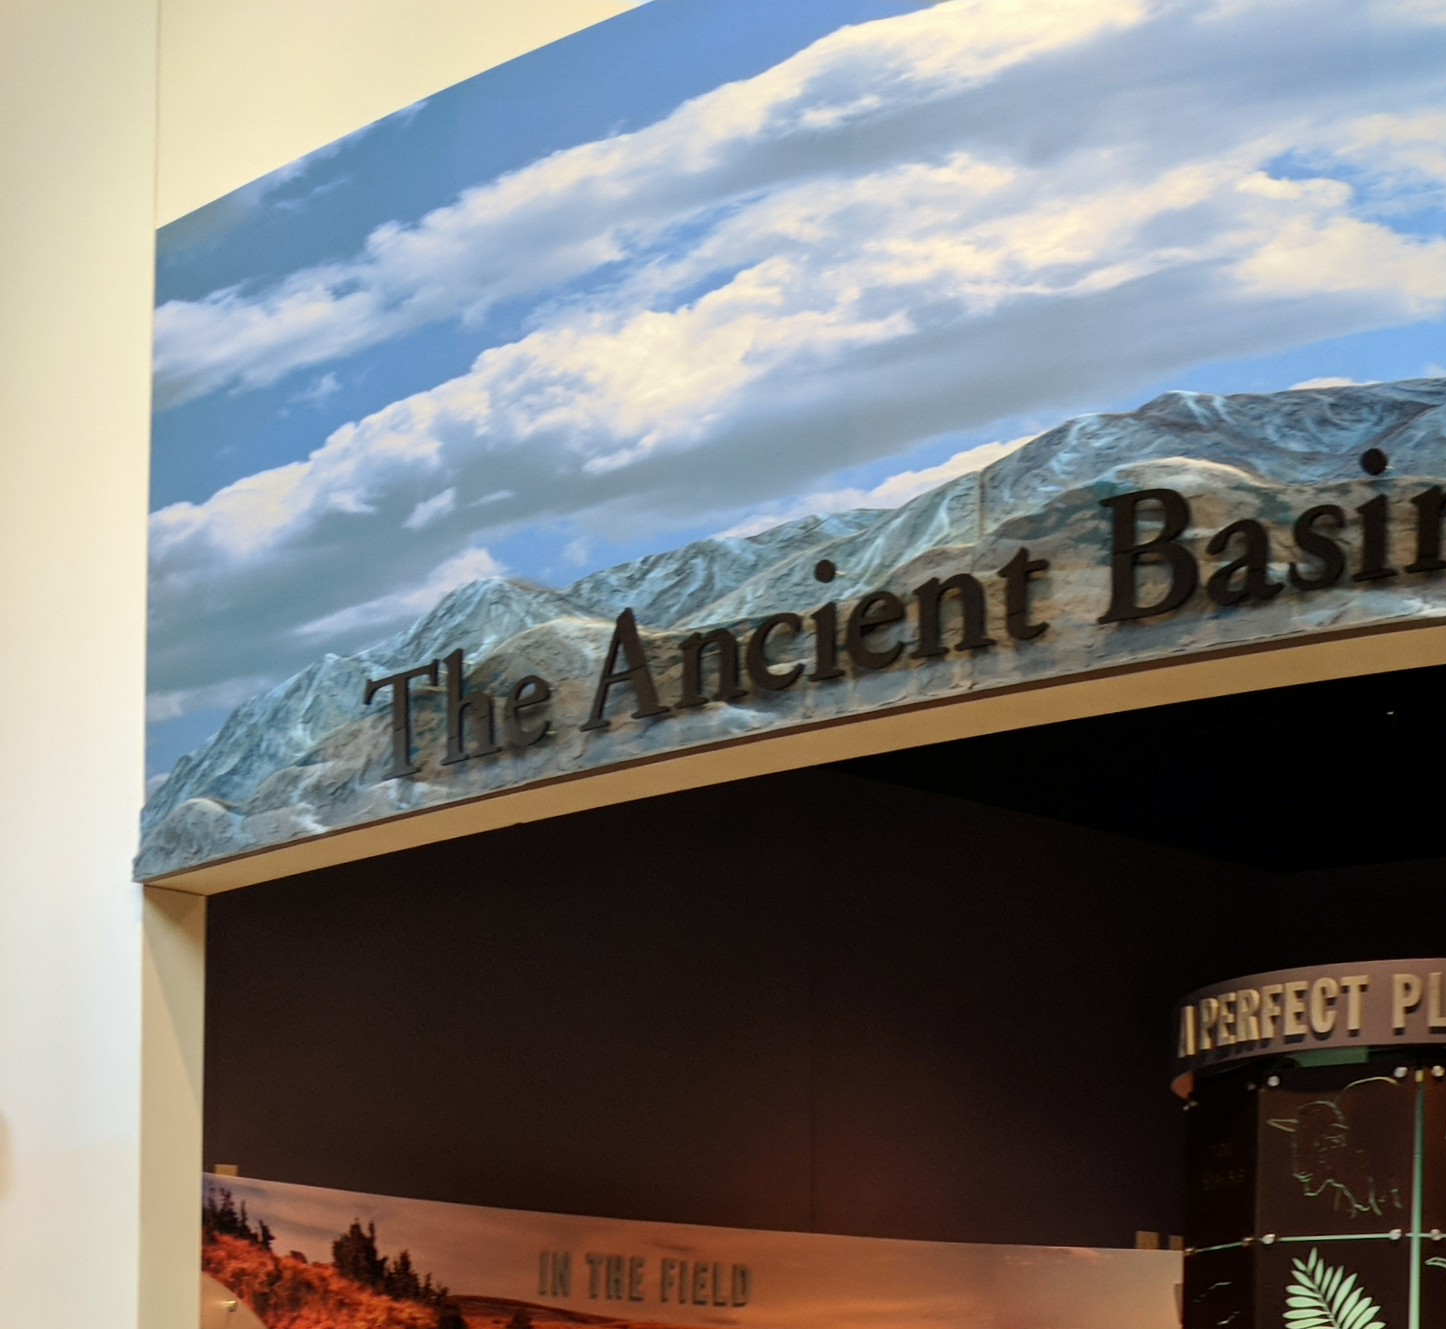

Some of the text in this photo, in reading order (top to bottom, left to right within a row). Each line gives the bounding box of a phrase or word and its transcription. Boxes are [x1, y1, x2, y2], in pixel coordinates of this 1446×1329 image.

[363, 648, 552, 782] The
[580, 547, 1051, 732] Ancient
[1200, 975, 1368, 1050] PERFECT
[539, 1251, 748, 1307] IN THE FIELD
